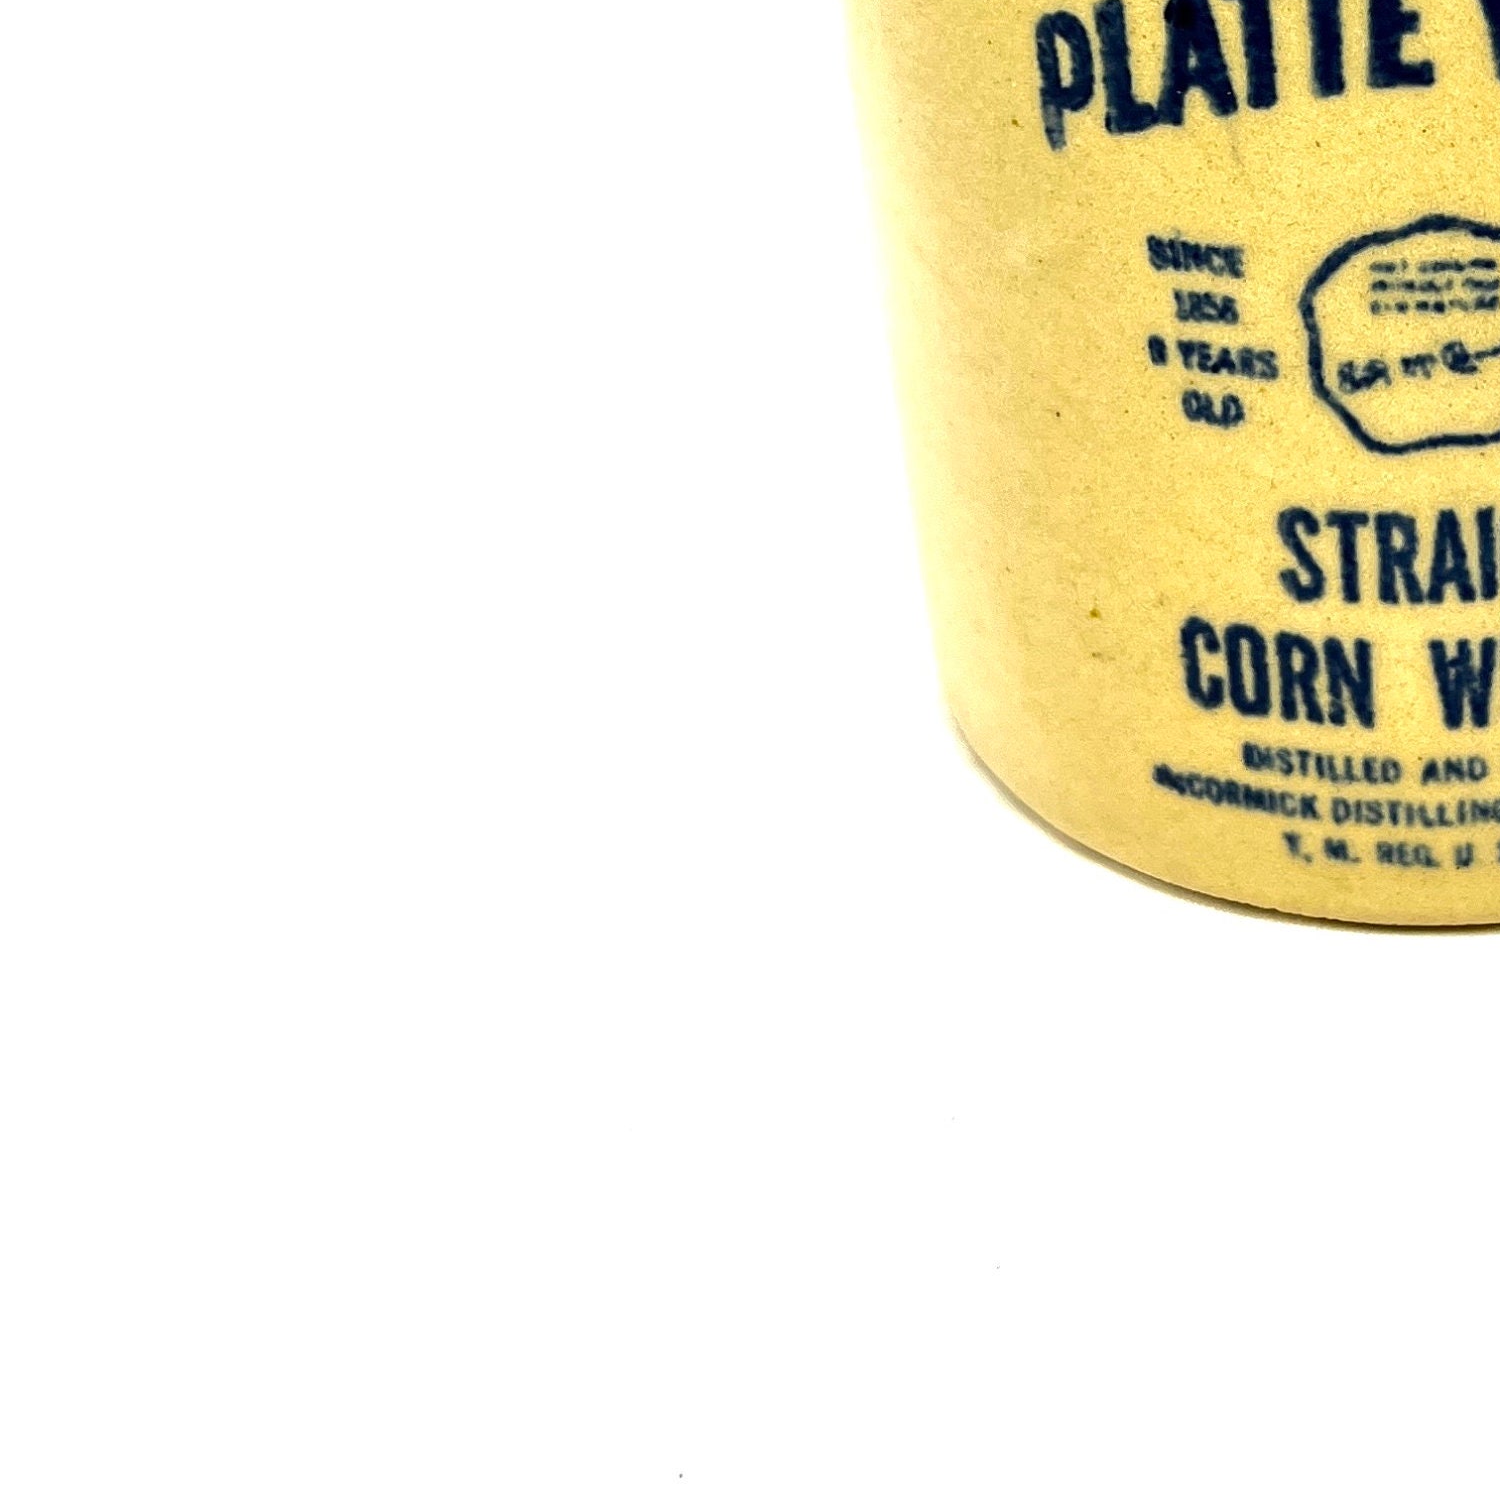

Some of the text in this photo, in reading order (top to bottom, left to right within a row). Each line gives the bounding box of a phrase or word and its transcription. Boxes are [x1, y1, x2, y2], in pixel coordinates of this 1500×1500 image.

[1179, 615, 1376, 730] CORN
[1241, 741, 1402, 784] DISTILLED
[1421, 756, 1488, 786] AND
